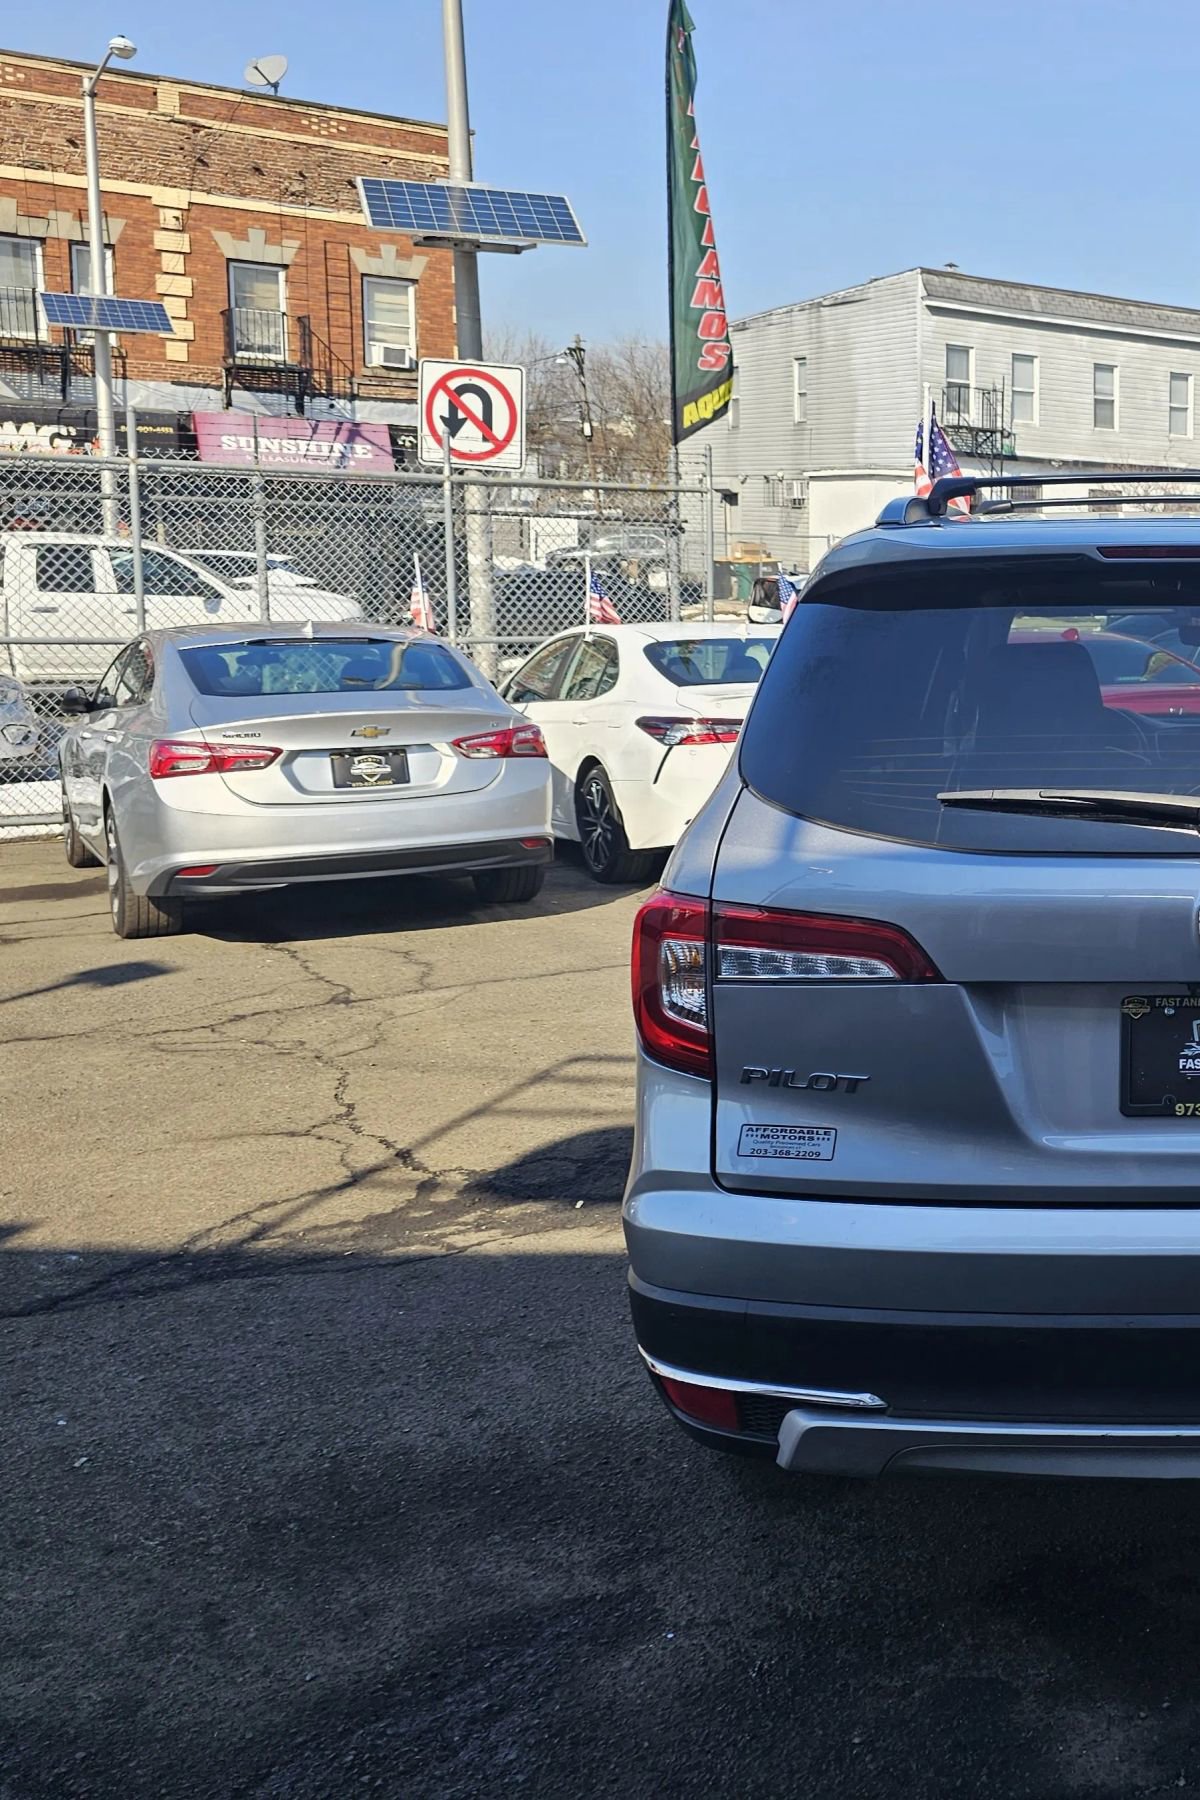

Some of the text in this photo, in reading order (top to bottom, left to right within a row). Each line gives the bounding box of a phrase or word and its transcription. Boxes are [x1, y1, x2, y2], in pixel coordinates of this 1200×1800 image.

[220, 435, 373, 459] SUNSHINE
[1155, 998, 1180, 1009] FAST
[739, 1066, 872, 1094] PILOT
[745, 1127, 832, 1137] AFFORDABLE
[749, 1147, 822, 1158] 203-368-2209
